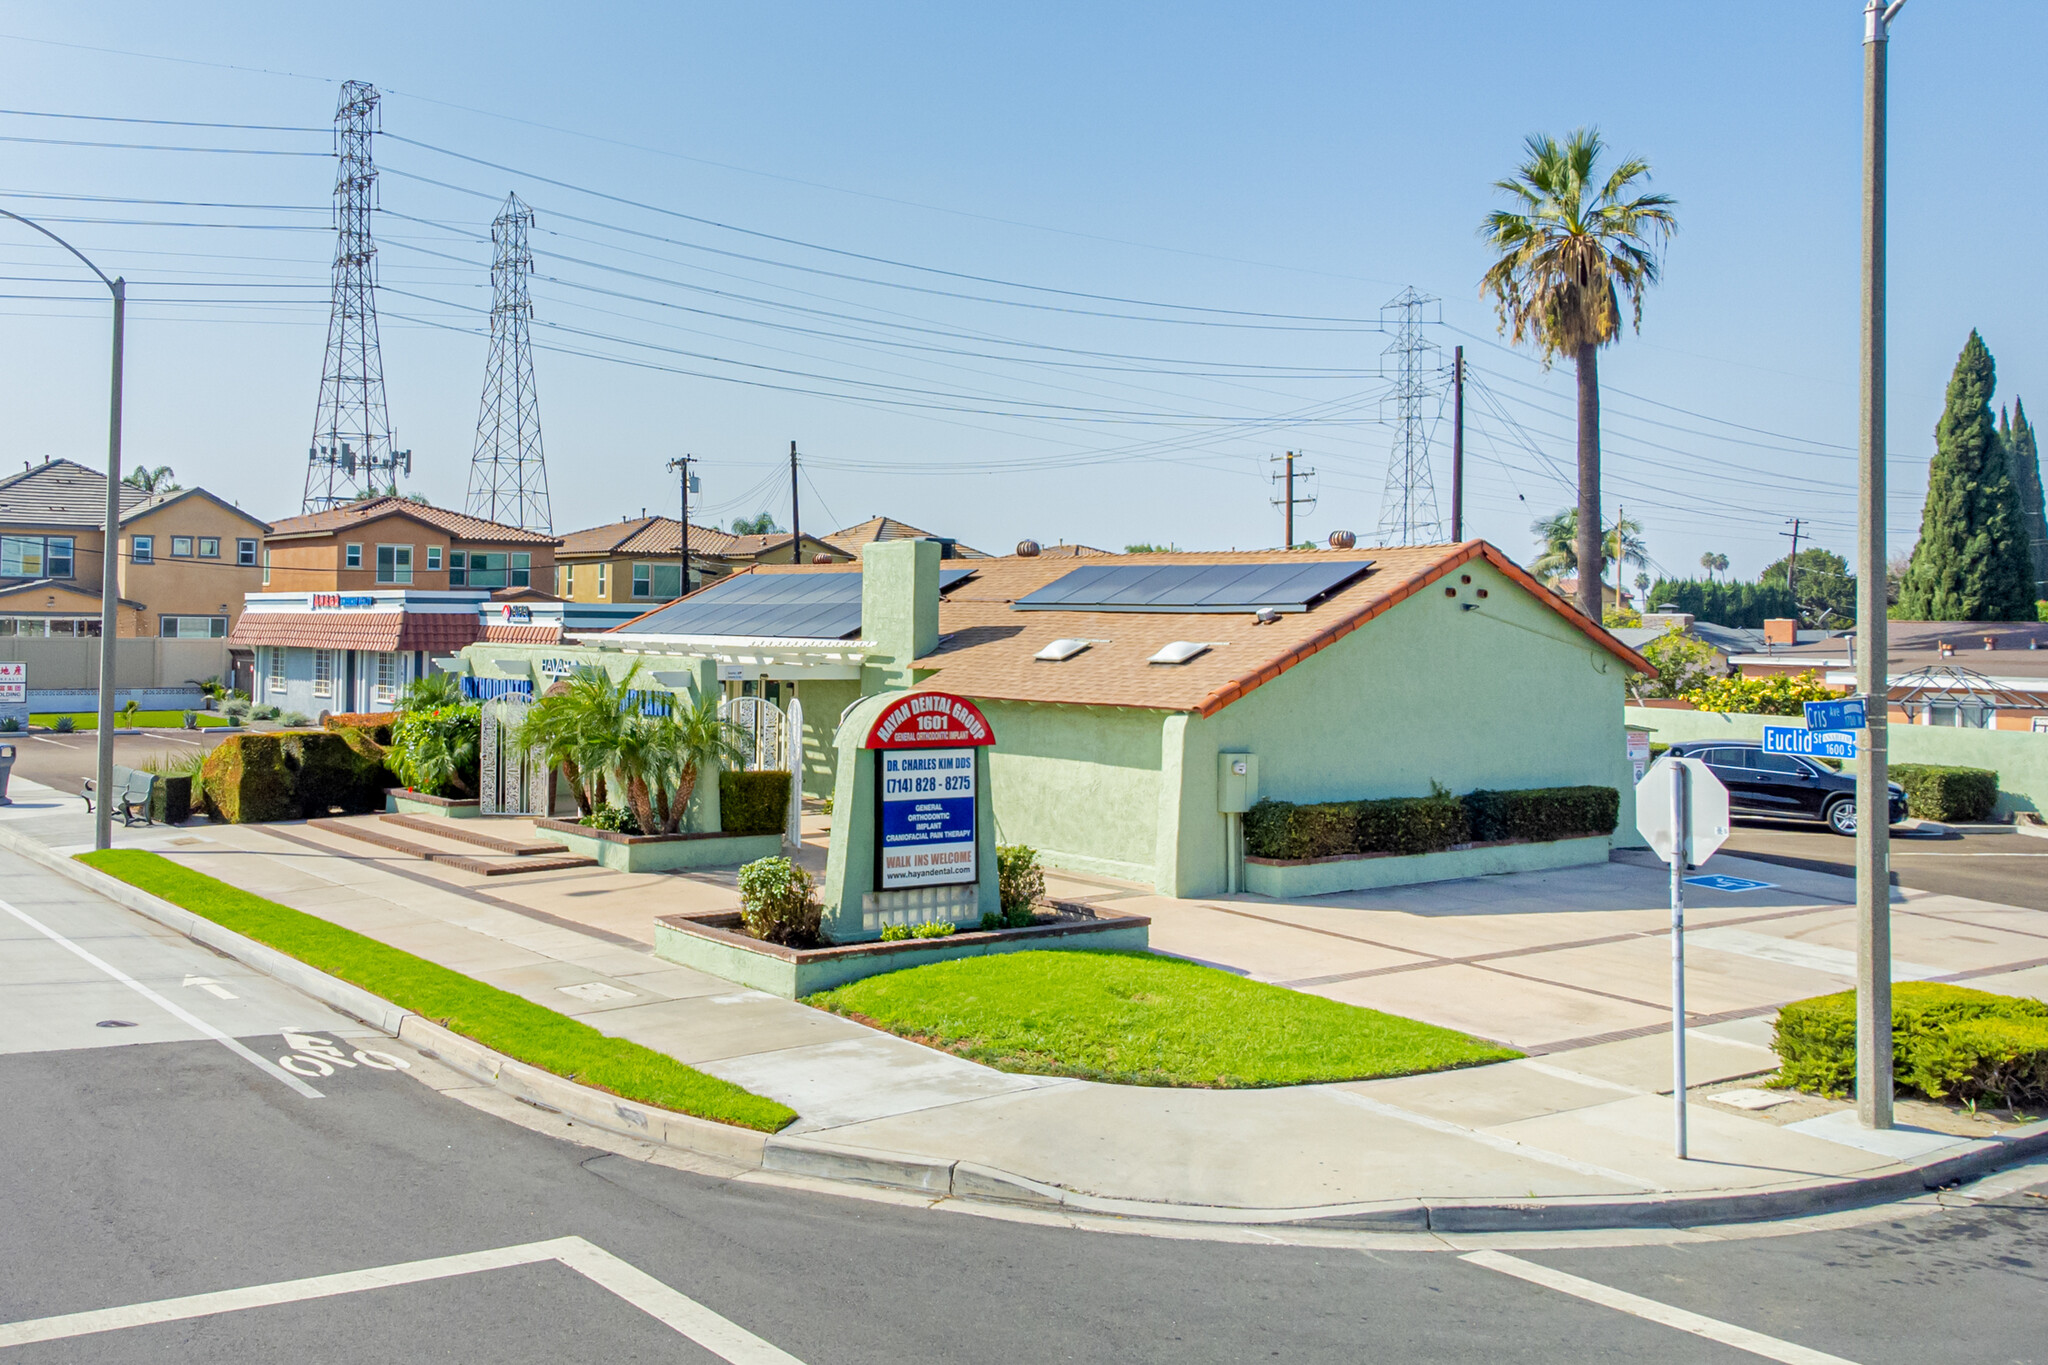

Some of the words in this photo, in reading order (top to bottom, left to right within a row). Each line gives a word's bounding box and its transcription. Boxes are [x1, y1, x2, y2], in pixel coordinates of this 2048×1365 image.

[877, 703, 911, 742] HAYAN
[910, 696, 952, 715] DENTAL
[952, 703, 985, 739] GROUP
[917, 715, 948, 730] 1601
[1807, 705, 1827, 728] Cris
[1829, 706, 1840, 717] Ave
[894, 732, 916, 742] GENERAL
[916, 731, 949, 741] ORTHODONTIC
[949, 731, 968, 740] IMPLANT
[1767, 730, 1812, 753] Euclid
[1813, 732, 1822, 744] St
[1826, 743, 1845, 756] 1600
[1847, 745, 1853, 756] S
[887, 760, 900, 772] DR.
[902, 758, 937, 771] CHARLES
[938, 758, 953, 769] KIM
[955, 757, 971, 769] DDS
[887, 778, 912, 793] (714)
[915, 777, 936, 792] 828
[945, 776, 970, 790] 8275
[915, 804, 943, 812] GENERAL
[908, 812, 950, 822] ORTHODONTIC
[916, 822, 942, 831] IMPLANT
[886, 832, 928, 842] CRANIOFACIAL
[929, 831, 943, 839] PAIN
[944, 829, 971, 838] THERAPY
[886, 855, 911, 868] WALK
[914, 854, 929, 866] INS
[931, 851, 972, 865] WELCOME
[887, 867, 970, 879] www.hayandental.com
